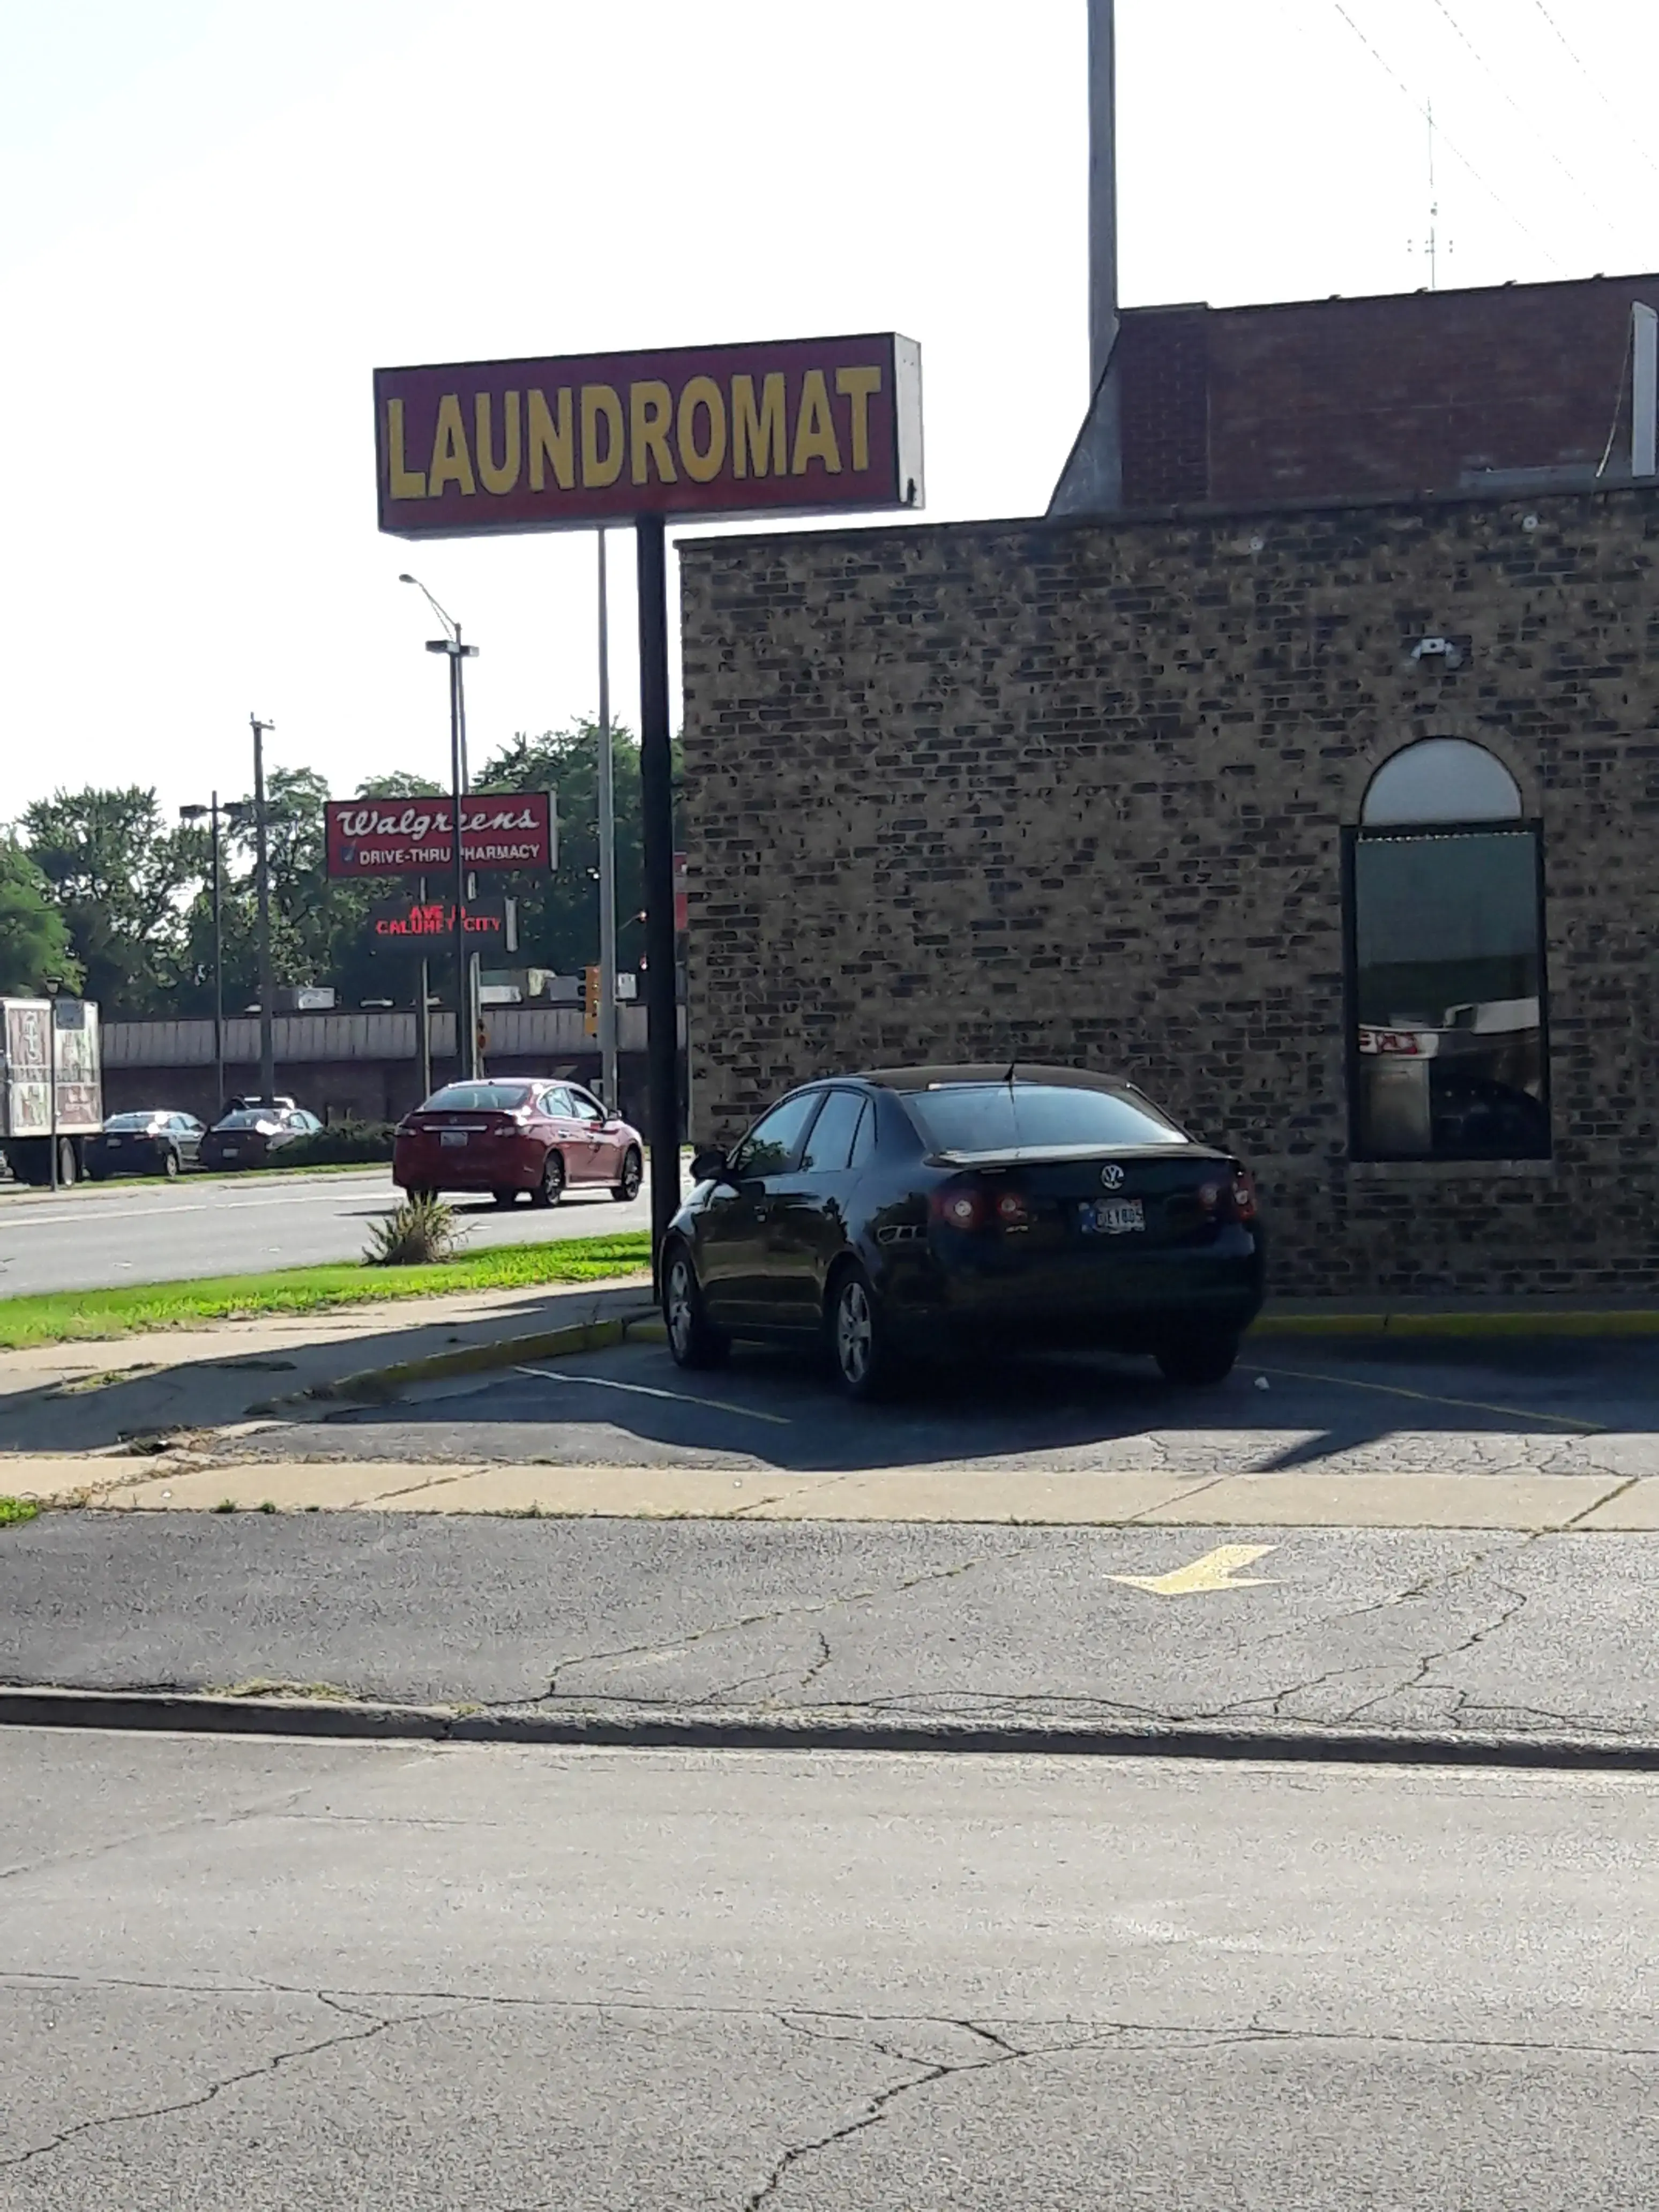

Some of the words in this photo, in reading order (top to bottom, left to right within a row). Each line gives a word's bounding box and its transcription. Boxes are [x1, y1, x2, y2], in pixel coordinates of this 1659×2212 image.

[387, 366, 881, 500] LAUNDROMAT
[337, 808, 540, 841] Walgreens
[359, 847, 451, 865] DRIVE-THRU
[463, 916, 500, 931] CITY
